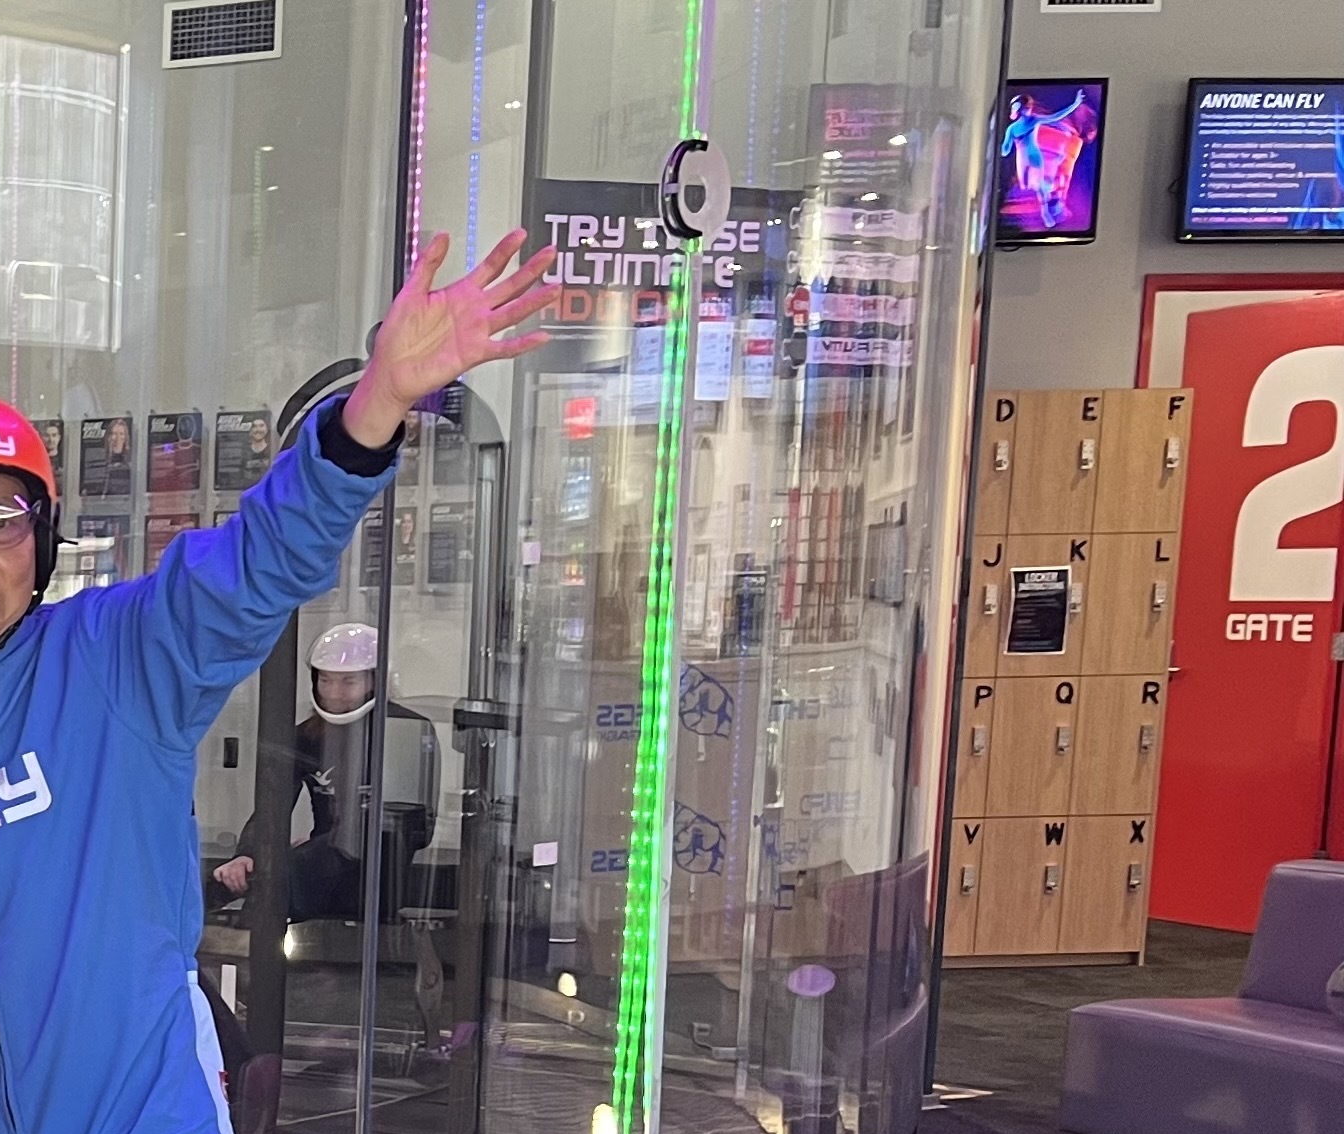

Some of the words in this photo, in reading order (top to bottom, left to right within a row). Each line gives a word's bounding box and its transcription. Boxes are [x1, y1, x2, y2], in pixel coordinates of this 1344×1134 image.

[1200, 93, 1262, 109] ANYONE
[1263, 93, 1294, 109] CAN
[1296, 93, 1325, 109] FLY
[544, 213, 626, 249] TRY
[634, 216, 760, 253] TSE
[995, 398, 1015, 422] D
[1081, 397, 1100, 421] E
[1168, 396, 1186, 420] F
[1229, 345, 1344, 602] 2
[983, 543, 1002, 567] J
[1070, 539, 1087, 562] K
[1155, 538, 1170, 562] L
[1225, 613, 1314, 642] GATE
[975, 685, 993, 708] P
[1055, 681, 1074, 704] Q
[1141, 681, 1160, 704] R
[964, 823, 981, 845] V
[1045, 823, 1065, 846] W
[1129, 820, 1146, 843] X
